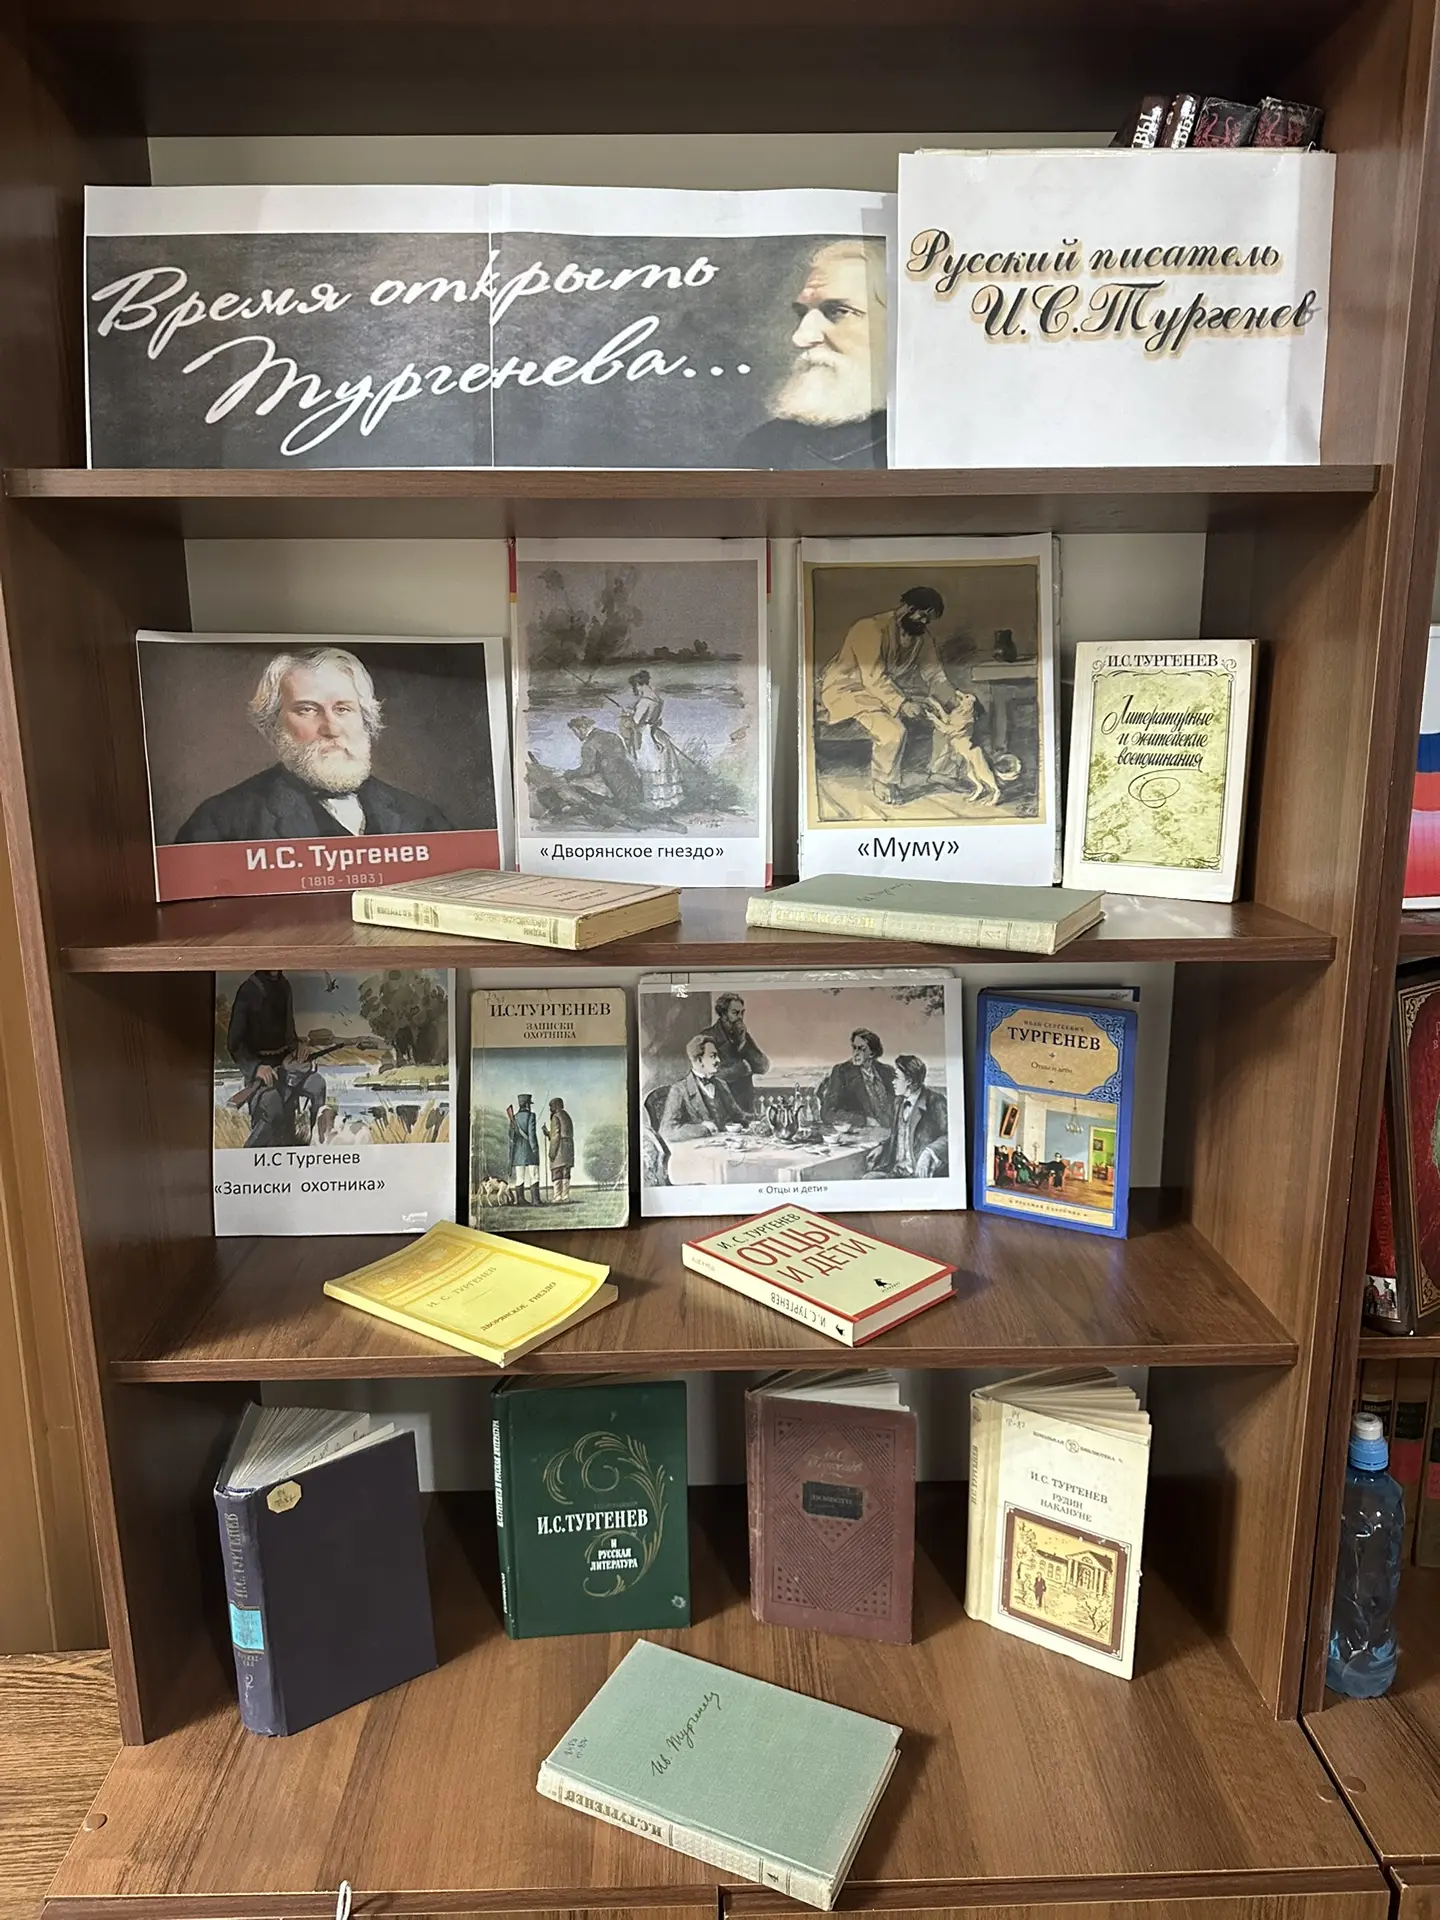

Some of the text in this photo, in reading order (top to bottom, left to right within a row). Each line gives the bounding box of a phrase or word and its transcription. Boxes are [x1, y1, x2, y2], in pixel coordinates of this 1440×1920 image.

[906, 227, 1282, 293] Русский писатель
[91, 247, 720, 360] Время открыть
[182, 315, 751, 457] Тургенева...
[1101, 694, 1215, 735] Литературные
[1116, 731, 1209, 748] и житейские
[1114, 746, 1203, 770] воспоминания
[246, 843, 430, 872] И.С. Тургенев
[540, 843, 724, 861] «Дворянское гнездо»
[858, 837, 960, 862] «Муму»
[523, 1030, 577, 1039] ОХОТНИКА
[526, 1021, 574, 1031] ЗАПИСКИ
[1007, 1026, 1101, 1051] ТУРГЕНЕВ
[253, 1151, 361, 1168] И.С Тургенев
[214, 1178, 386, 1196] «Записки охотника»
[744, 1212, 801, 1239] ТУРГЕНЕВ
[736, 1220, 842, 1266] ОТЦЫ
[777, 1237, 877, 1283] И ДЕТИ
[770, 1291, 809, 1320] ТУРГЕНЕВ
[1051, 1477, 1108, 1505] ТУРГЕНЕВ
[1052, 1493, 1083, 1510] РУДИН
[537, 1508, 649, 1535] И.С.ТУРГЕНЕВ
[1040, 1499, 1093, 1523] НАКАНУНЕ
[598, 1548, 632, 1560] РУССКАЯ
[610, 1538, 617, 1548] И
[590, 1558, 638, 1572] ЛИТЕРАТУРА
